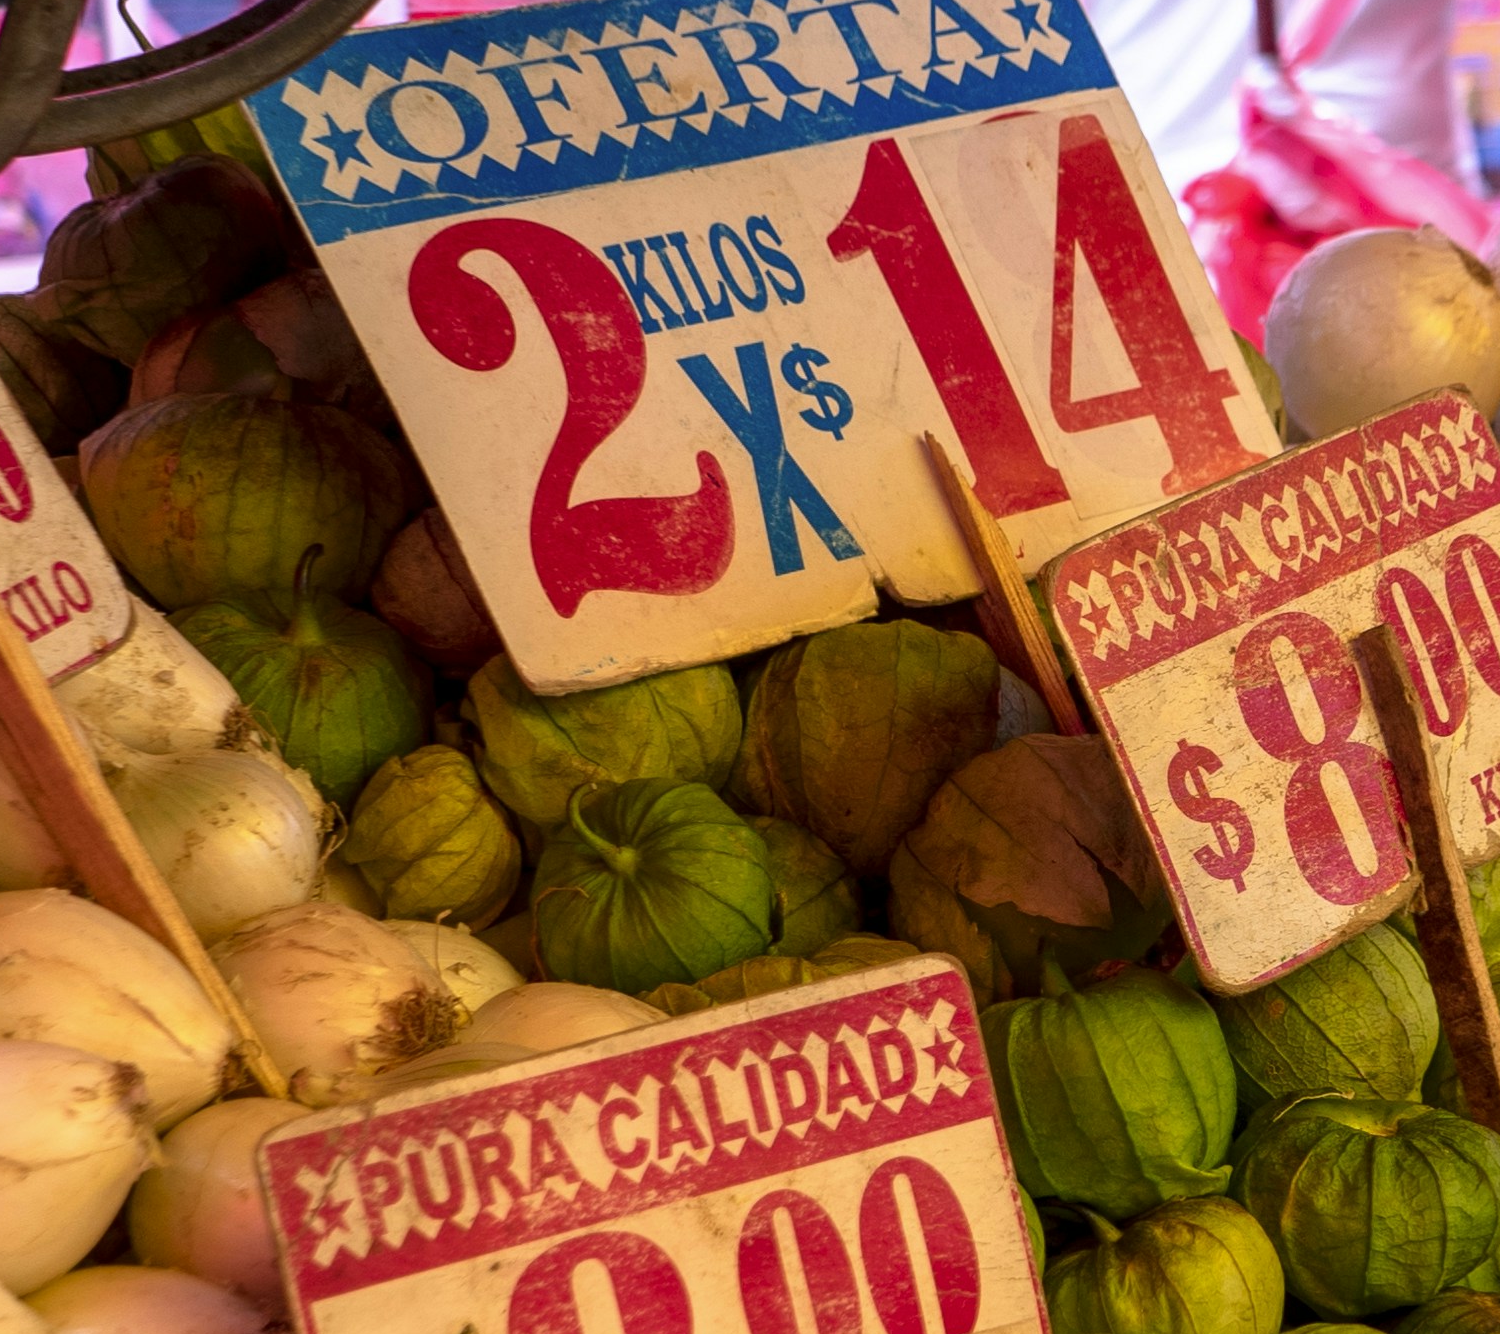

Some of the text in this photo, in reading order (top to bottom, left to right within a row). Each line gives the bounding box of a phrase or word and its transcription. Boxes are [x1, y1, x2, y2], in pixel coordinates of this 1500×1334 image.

[407, 217, 735, 620] 2
[602, 212, 806, 335] KILOS
[828, 112, 1270, 520] 14
[1105, 431, 1462, 635] PURA CALIDAD
[1167, 739, 1256, 895] $
[1233, 611, 1411, 907] 8
[357, 1026, 920, 1236] PURA CALIDAD
